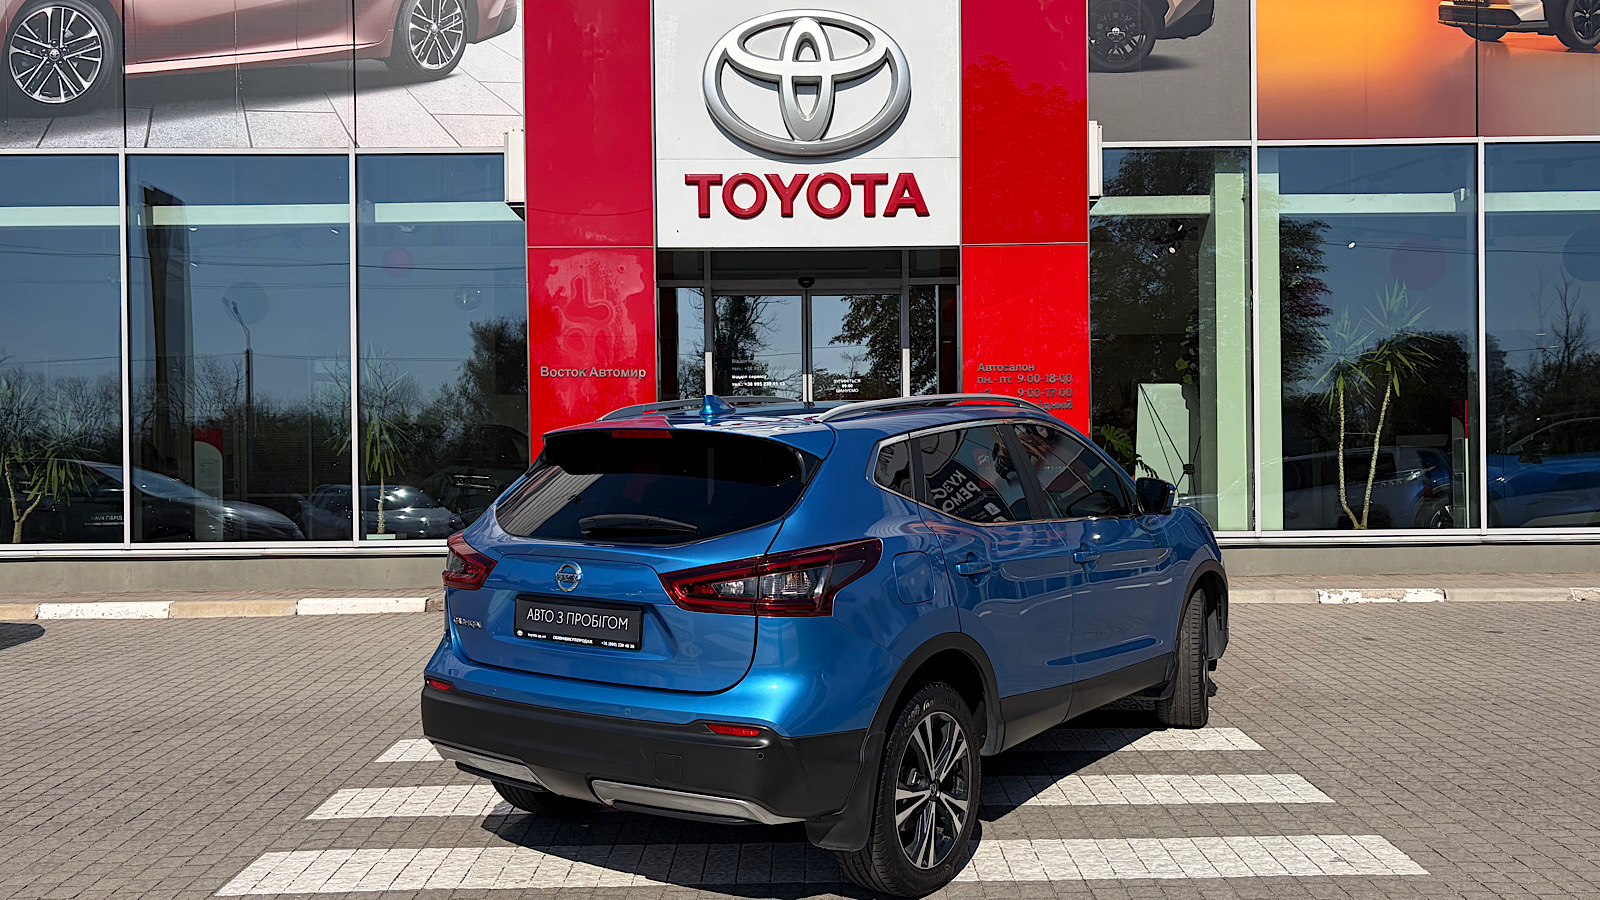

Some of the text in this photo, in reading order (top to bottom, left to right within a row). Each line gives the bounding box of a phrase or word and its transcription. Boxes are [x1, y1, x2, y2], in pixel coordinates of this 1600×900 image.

[684, 172, 930, 219] TOYOTA
[540, 366, 646, 380] Восток Автомир
[978, 363, 1035, 372] Автосалон
[999, 376, 1013, 384] пт.
[1017, 374, 1073, 383] 9:00-18:00
[1017, 388, 1073, 398] 9:00-17:00
[526, 608, 629, 630] АВТО З ПРОБІГОМ
